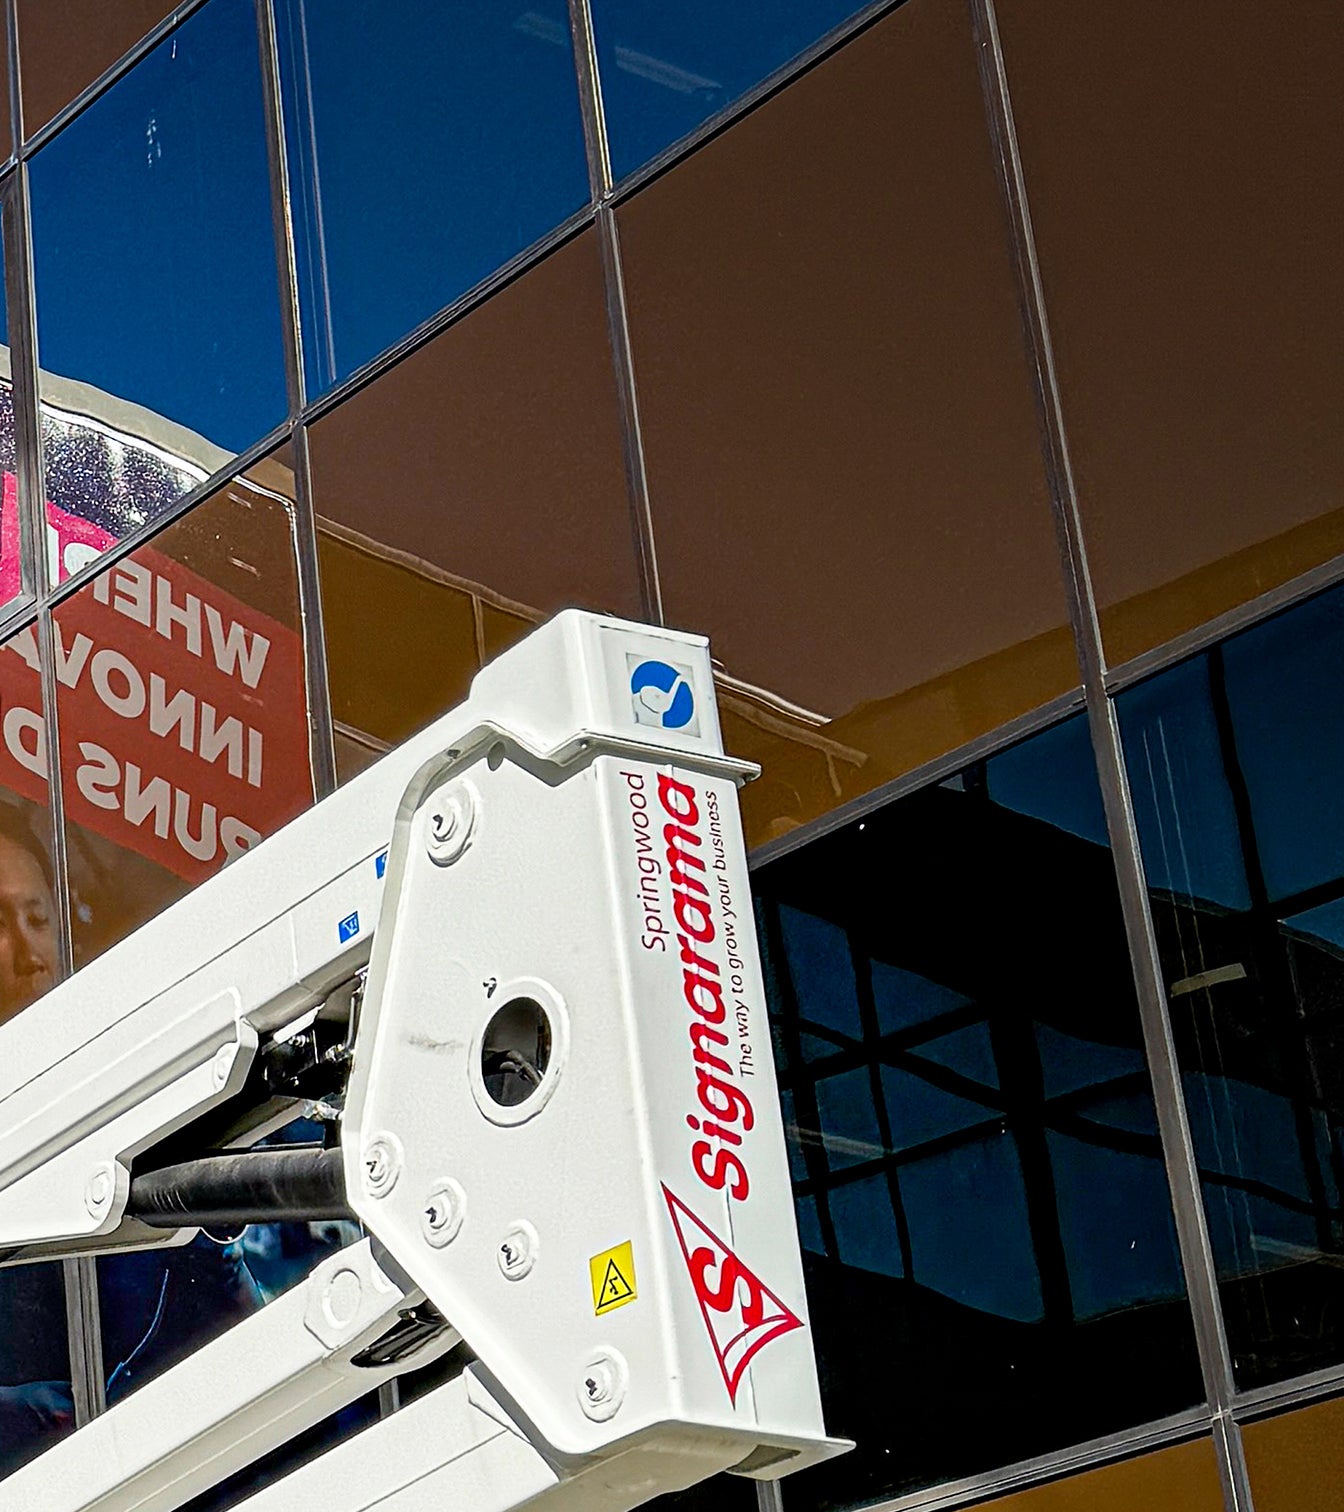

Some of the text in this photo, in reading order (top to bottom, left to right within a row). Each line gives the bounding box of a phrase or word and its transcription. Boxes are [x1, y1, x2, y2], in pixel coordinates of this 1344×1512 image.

[619, 770, 670, 953] Springwood
[656, 771, 755, 1202] Signarama
[705, 789, 755, 1078] The way to grow your business
